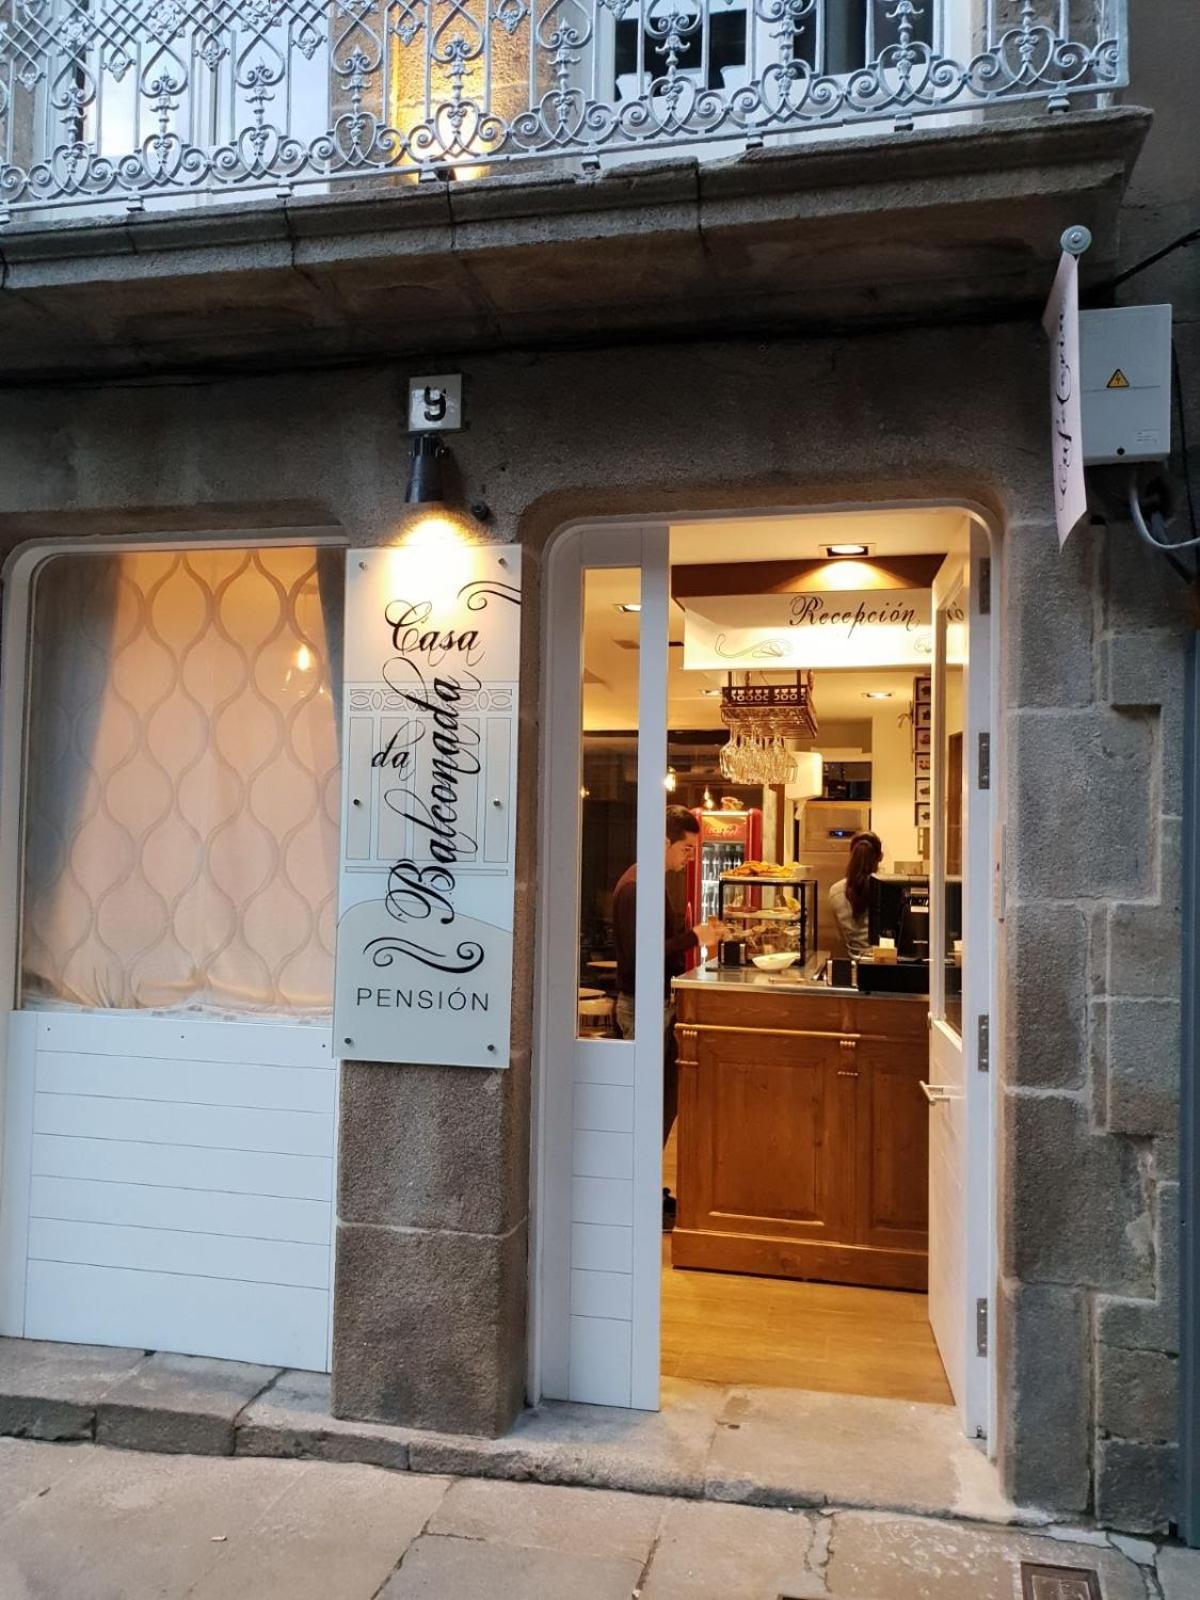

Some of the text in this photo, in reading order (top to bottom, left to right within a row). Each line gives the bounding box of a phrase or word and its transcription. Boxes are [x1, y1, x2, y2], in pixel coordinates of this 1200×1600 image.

[424, 386, 447, 422] 9
[385, 599, 485, 667] Casa
[789, 595, 921, 639] Recepción
[371, 720, 426, 782] da
[382, 656, 482, 925] Balconada
[356, 986, 489, 1011] PENSIÓN
